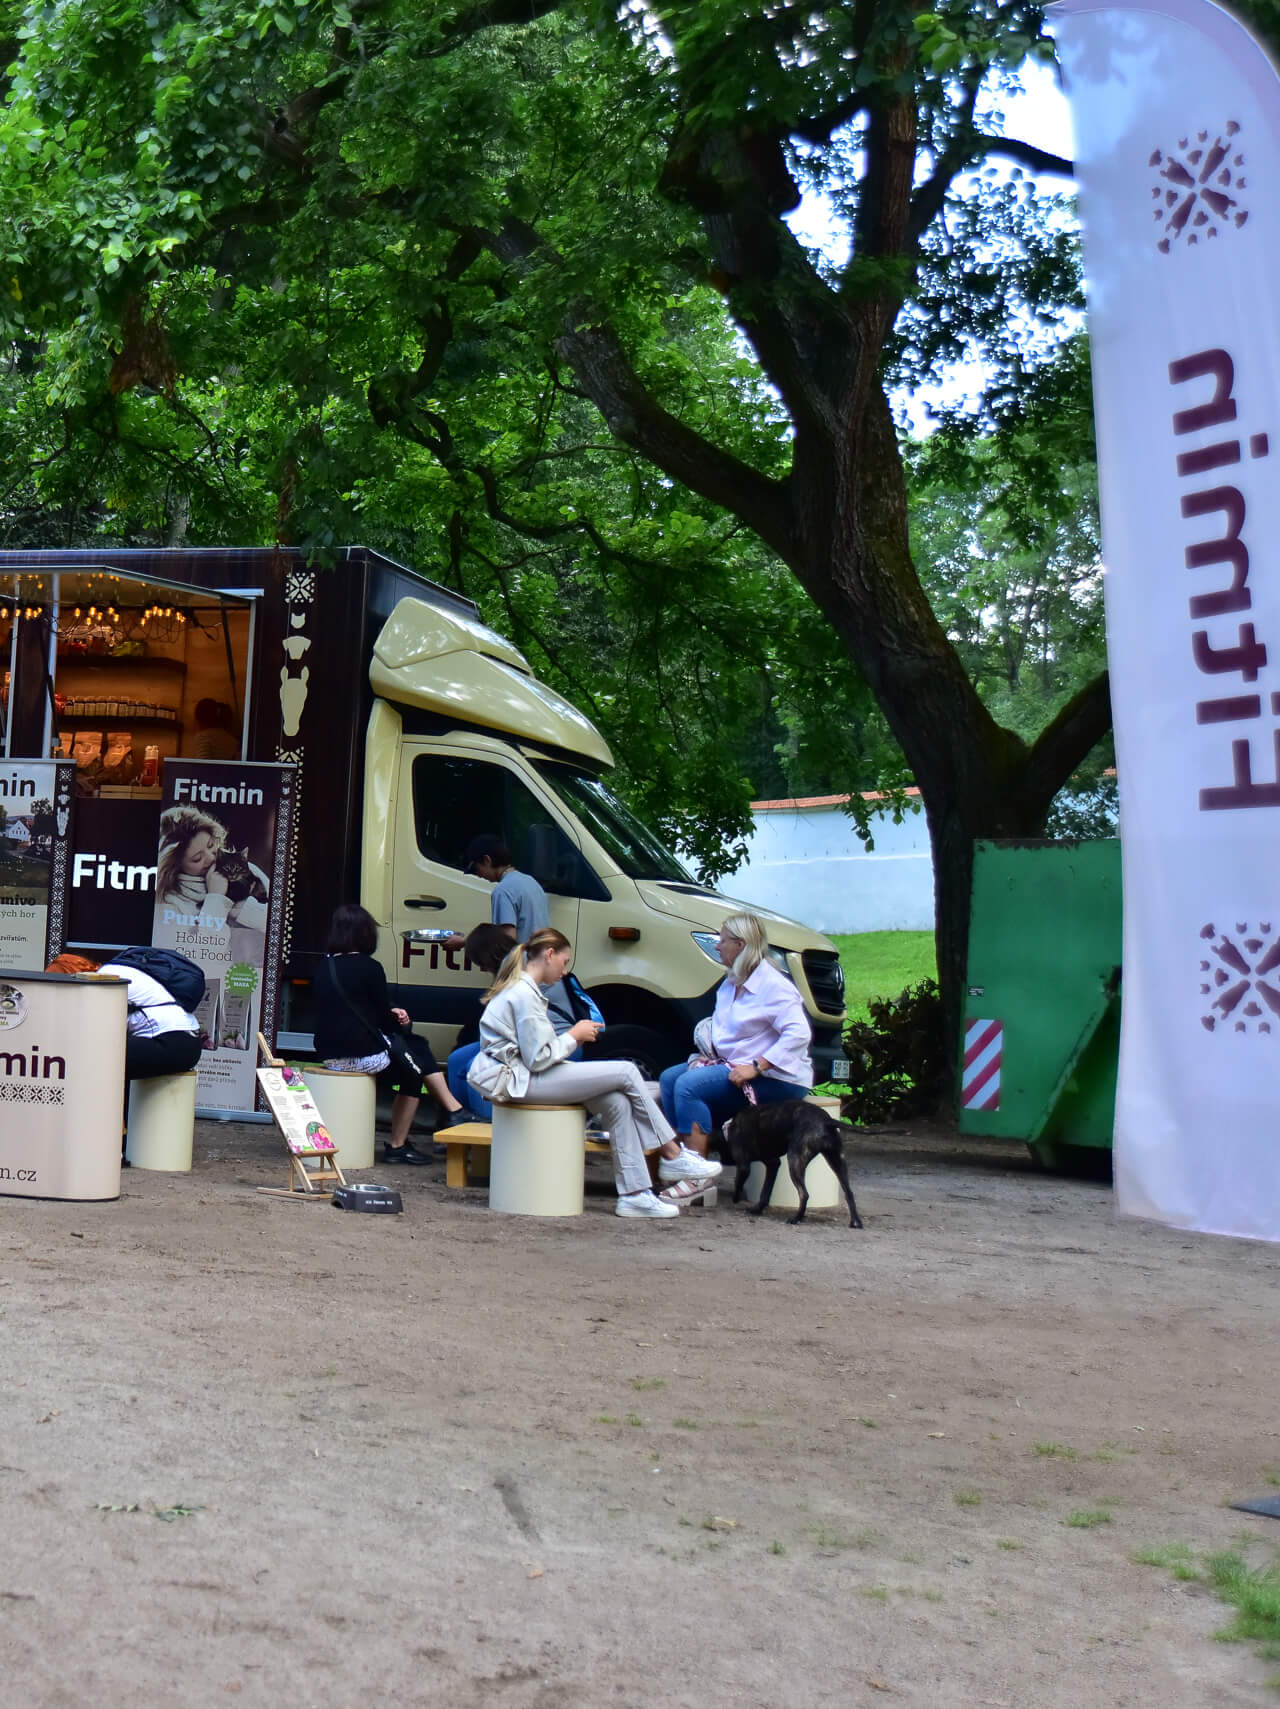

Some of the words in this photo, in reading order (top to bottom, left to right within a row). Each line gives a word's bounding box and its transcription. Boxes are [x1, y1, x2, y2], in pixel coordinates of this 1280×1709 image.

[173, 778, 263, 805] Fitmin
[19, 910, 37, 919] hor
[163, 909, 225, 932] Purity
[175, 931, 226, 946] Holistic
[200, 948, 233, 962] Food
